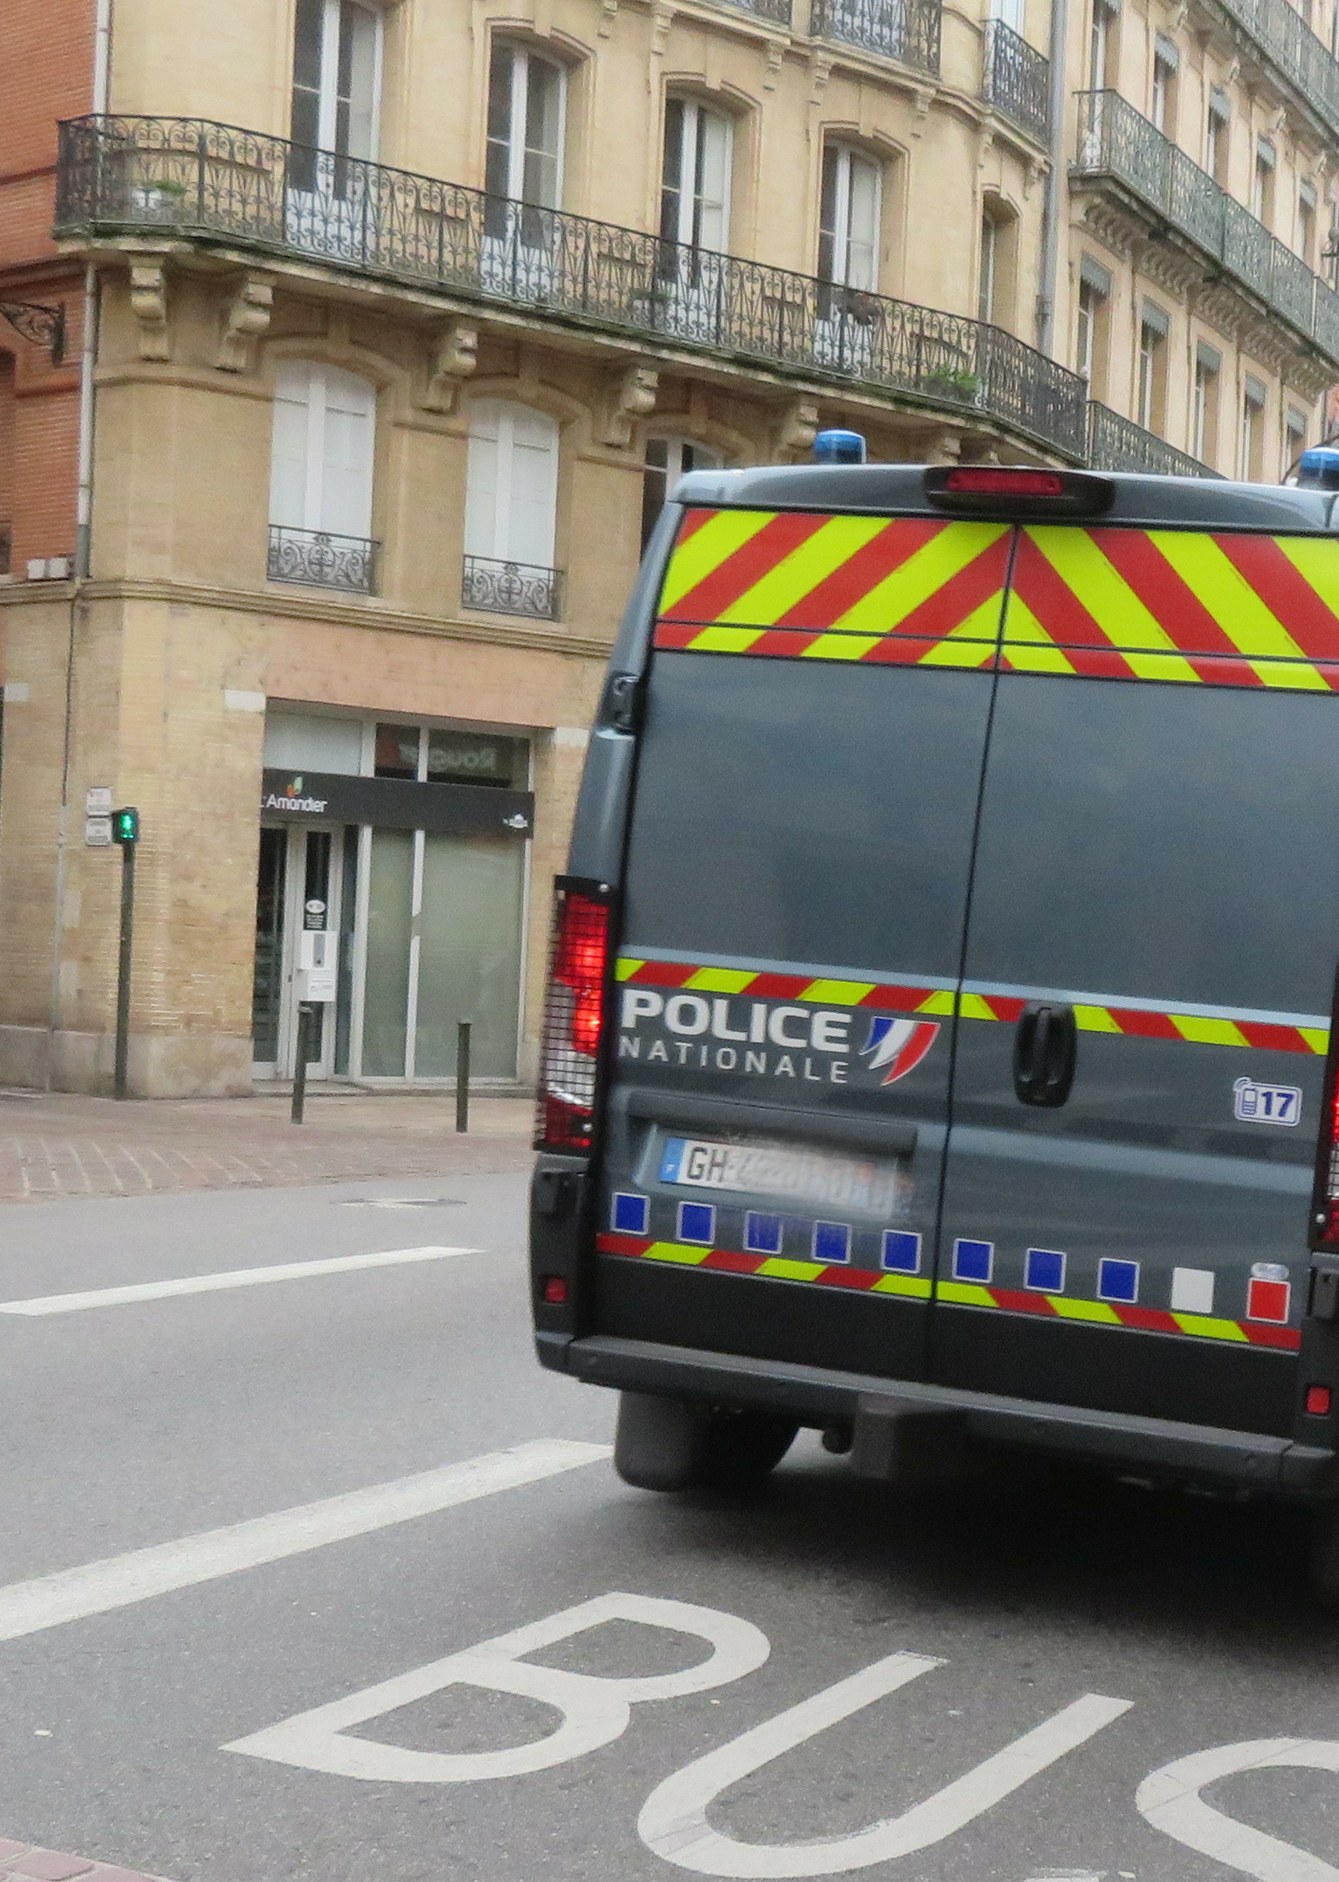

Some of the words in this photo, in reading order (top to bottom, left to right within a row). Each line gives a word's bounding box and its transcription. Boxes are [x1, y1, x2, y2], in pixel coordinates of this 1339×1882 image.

[620, 988, 853, 1054] POLICE
[618, 1034, 850, 1085] NATIONALE
[1261, 1091, 1295, 1118] 17
